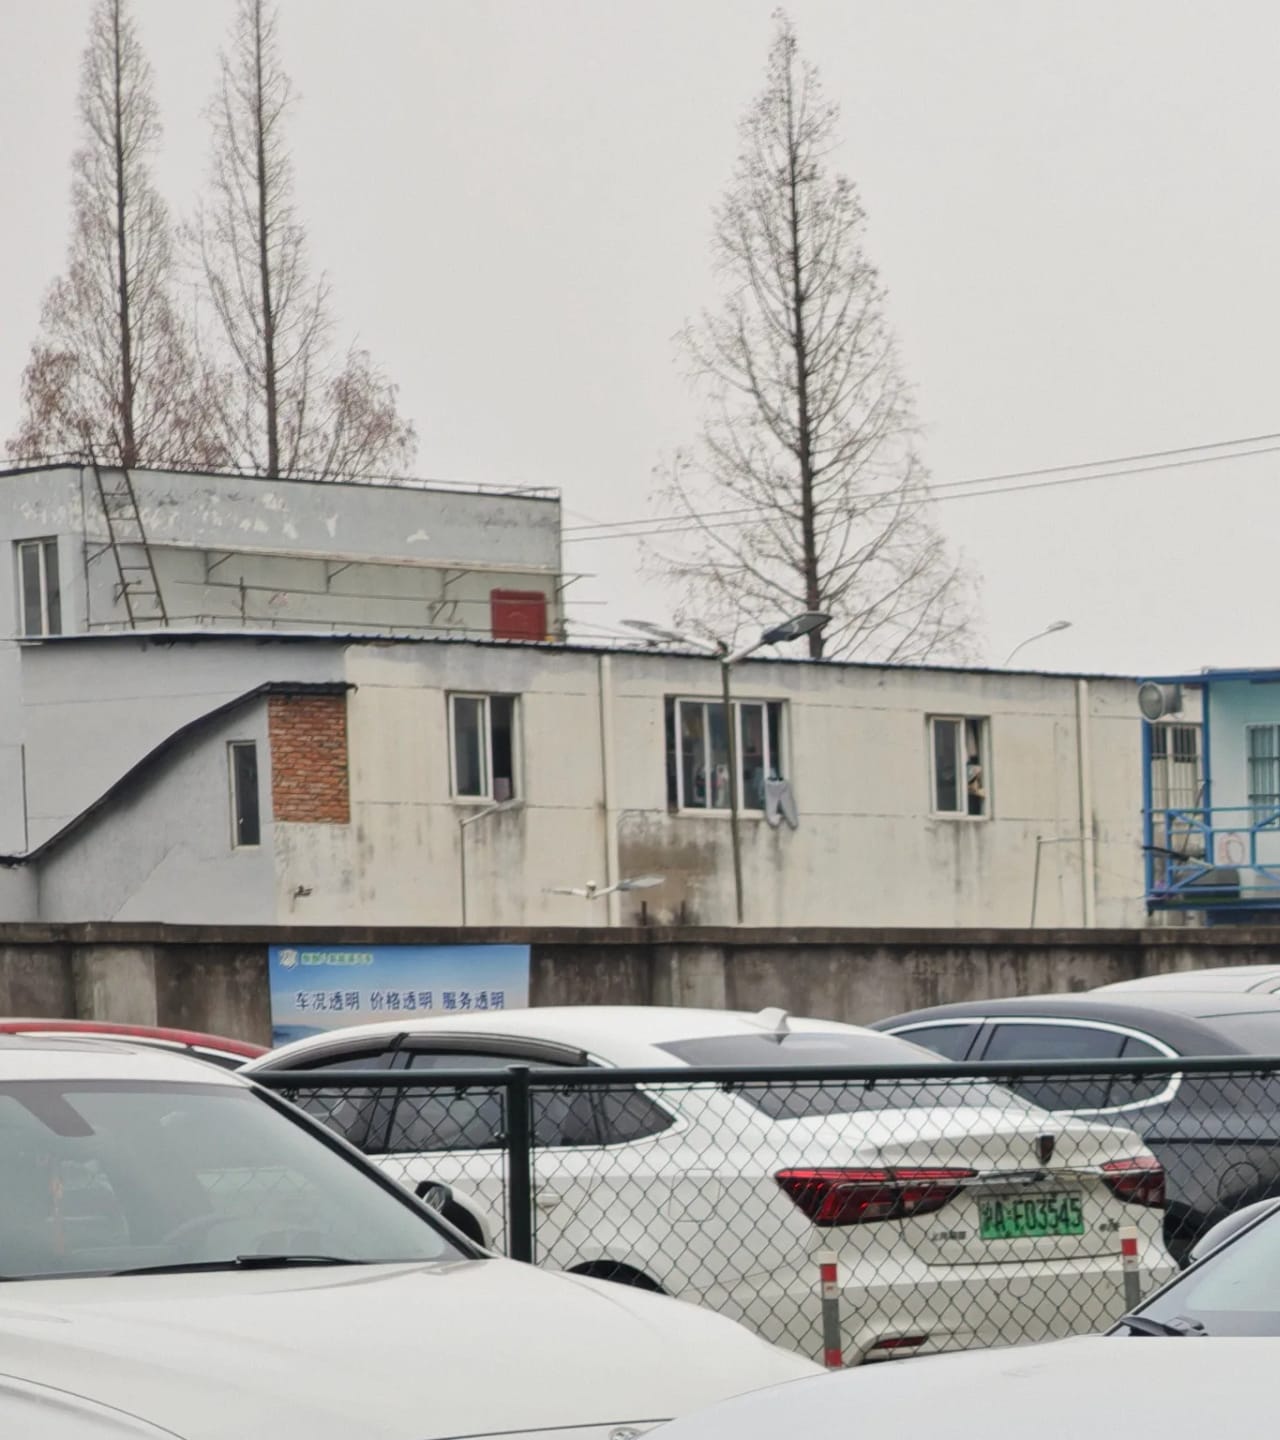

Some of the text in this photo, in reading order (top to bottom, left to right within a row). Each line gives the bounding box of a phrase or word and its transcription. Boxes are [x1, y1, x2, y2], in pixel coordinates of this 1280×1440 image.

[295, 991, 506, 1011] 车况透明 价格透明 服务透明
